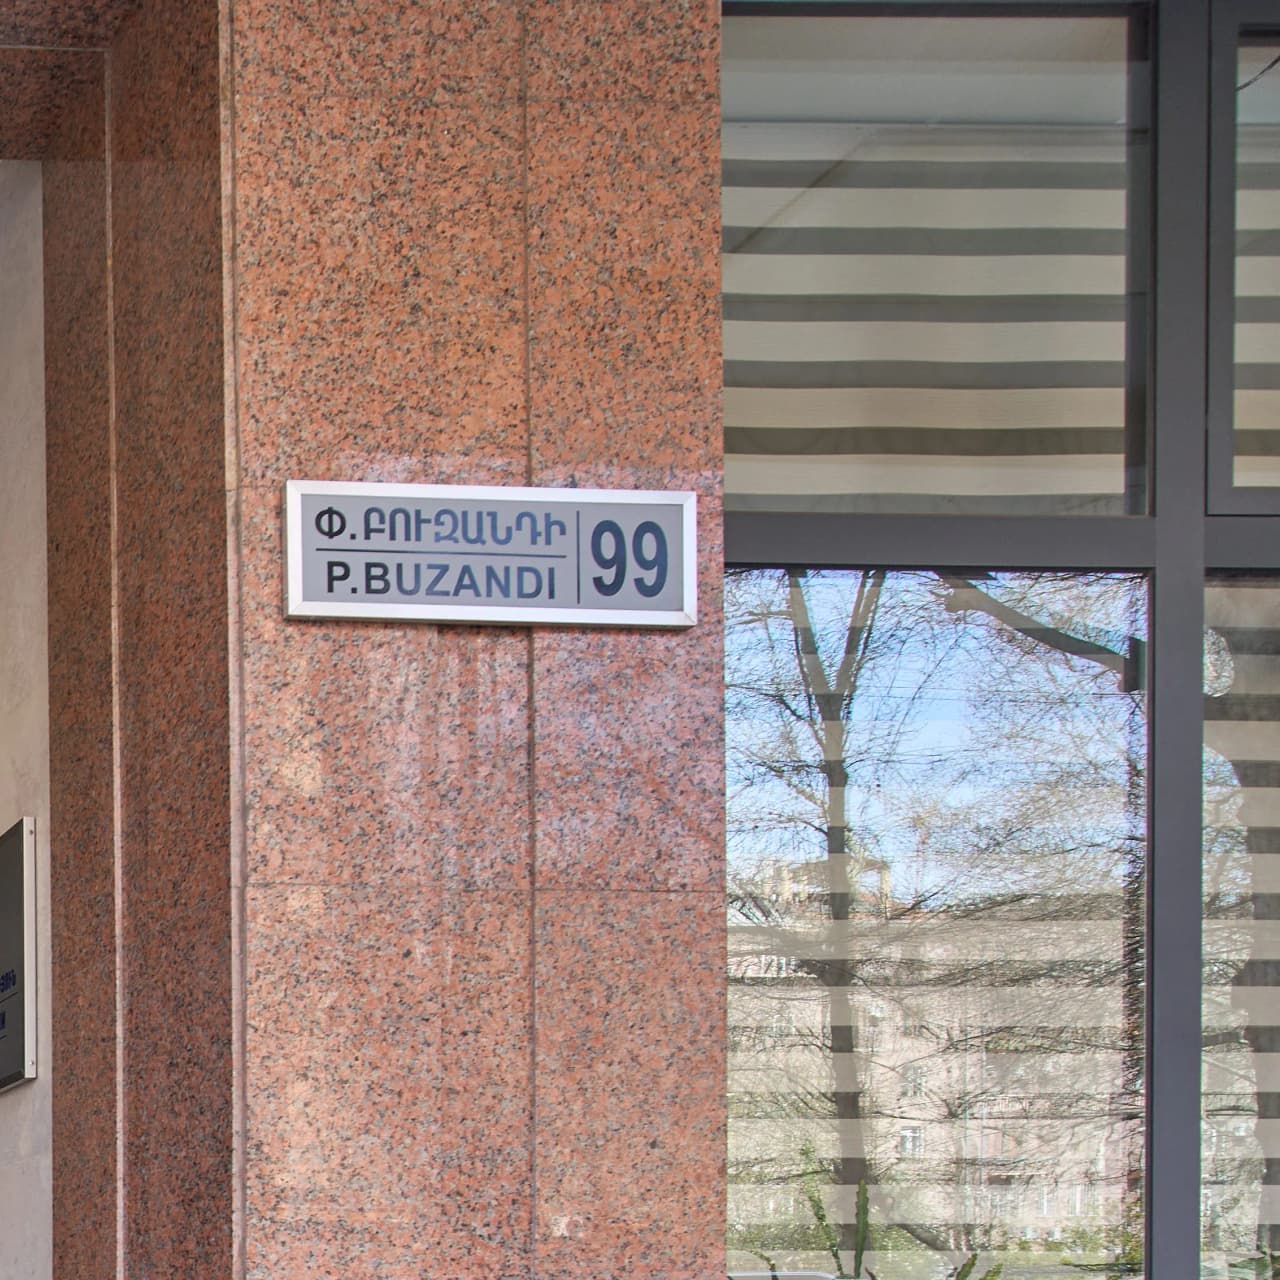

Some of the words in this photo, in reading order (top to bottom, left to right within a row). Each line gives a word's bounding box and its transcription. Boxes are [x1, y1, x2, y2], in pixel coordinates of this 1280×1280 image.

[314, 506, 567, 546] Փ.ԲՈՒԶԱՆԴԻ
[590, 519, 669, 598] 99
[326, 560, 556, 600] P.BUZANDI
